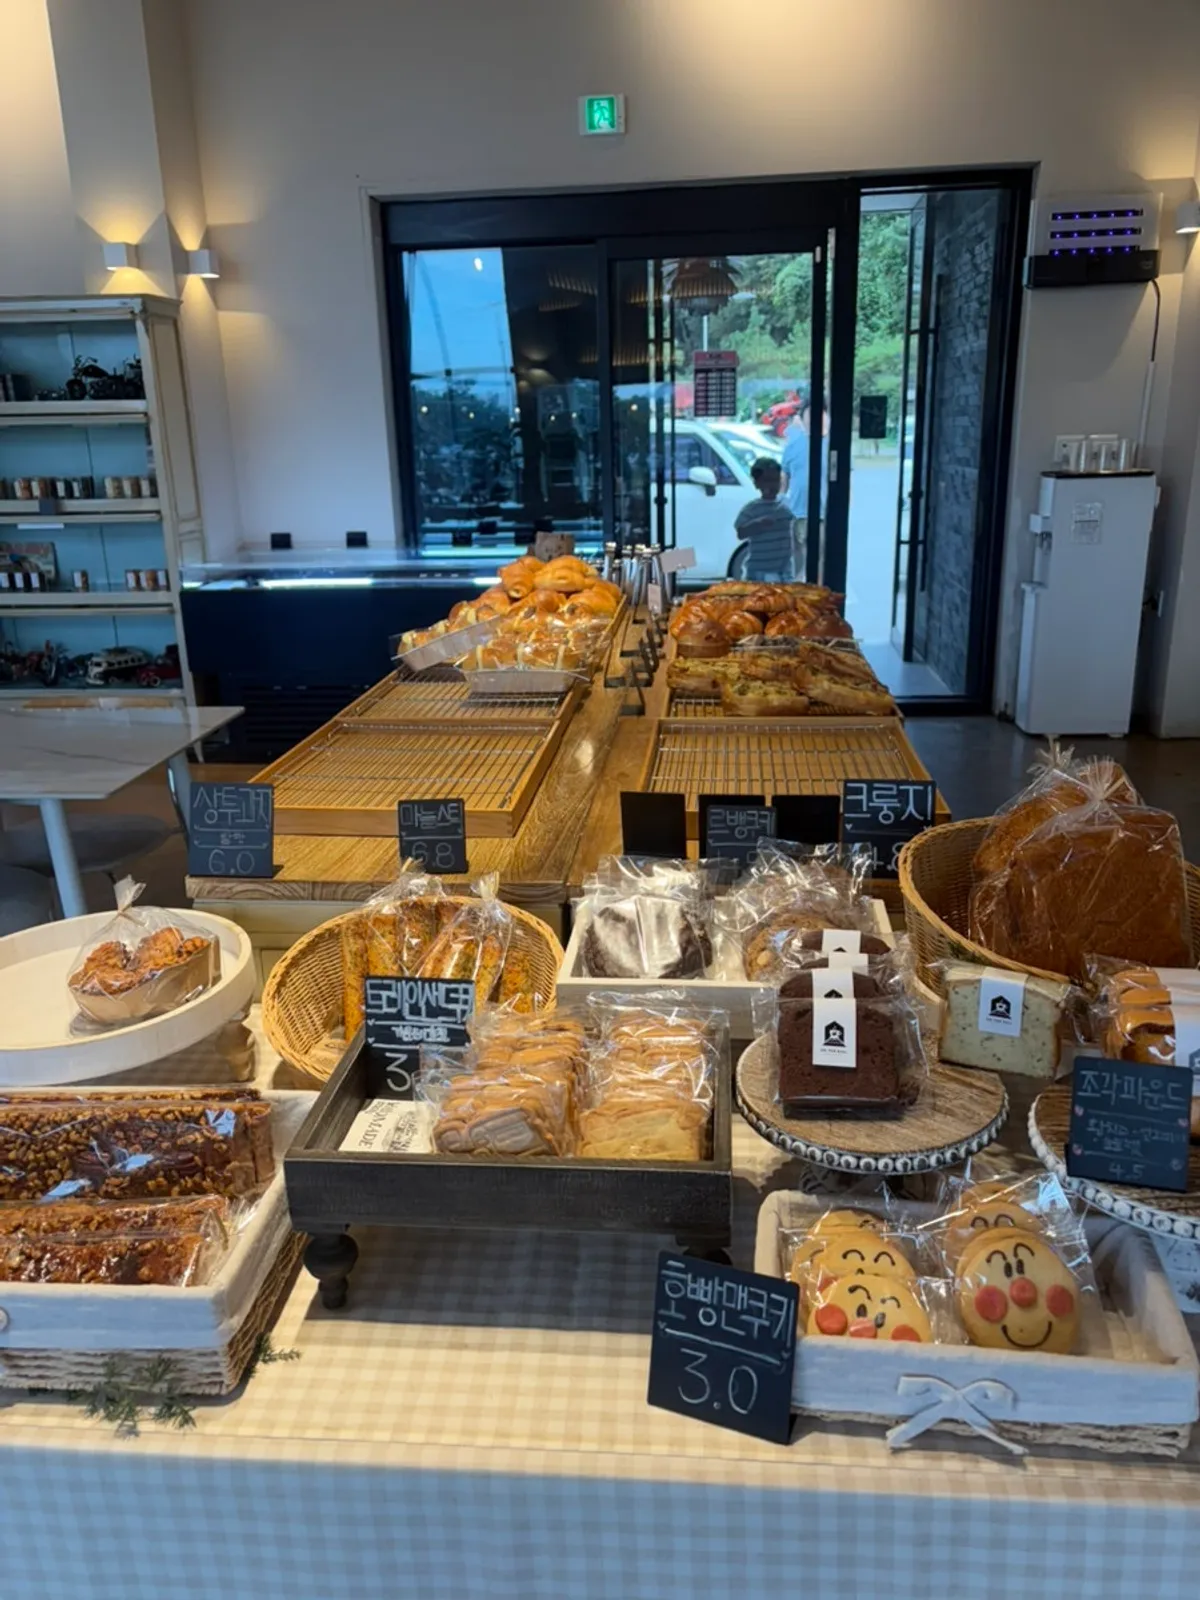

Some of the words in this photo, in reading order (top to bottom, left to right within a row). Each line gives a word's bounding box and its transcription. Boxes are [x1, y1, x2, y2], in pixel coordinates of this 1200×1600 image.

[193, 786, 272, 829] 상투과자
[708, 808, 776, 839] 르뱅쿠키
[843, 782, 932, 825] 크룽지
[208, 849, 255, 875] 6.0
[1077, 1070, 1188, 1111] 조각파운드
[658, 1259, 795, 1348] 호빵맨쿠키
[678, 1347, 758, 1415] 3.0
